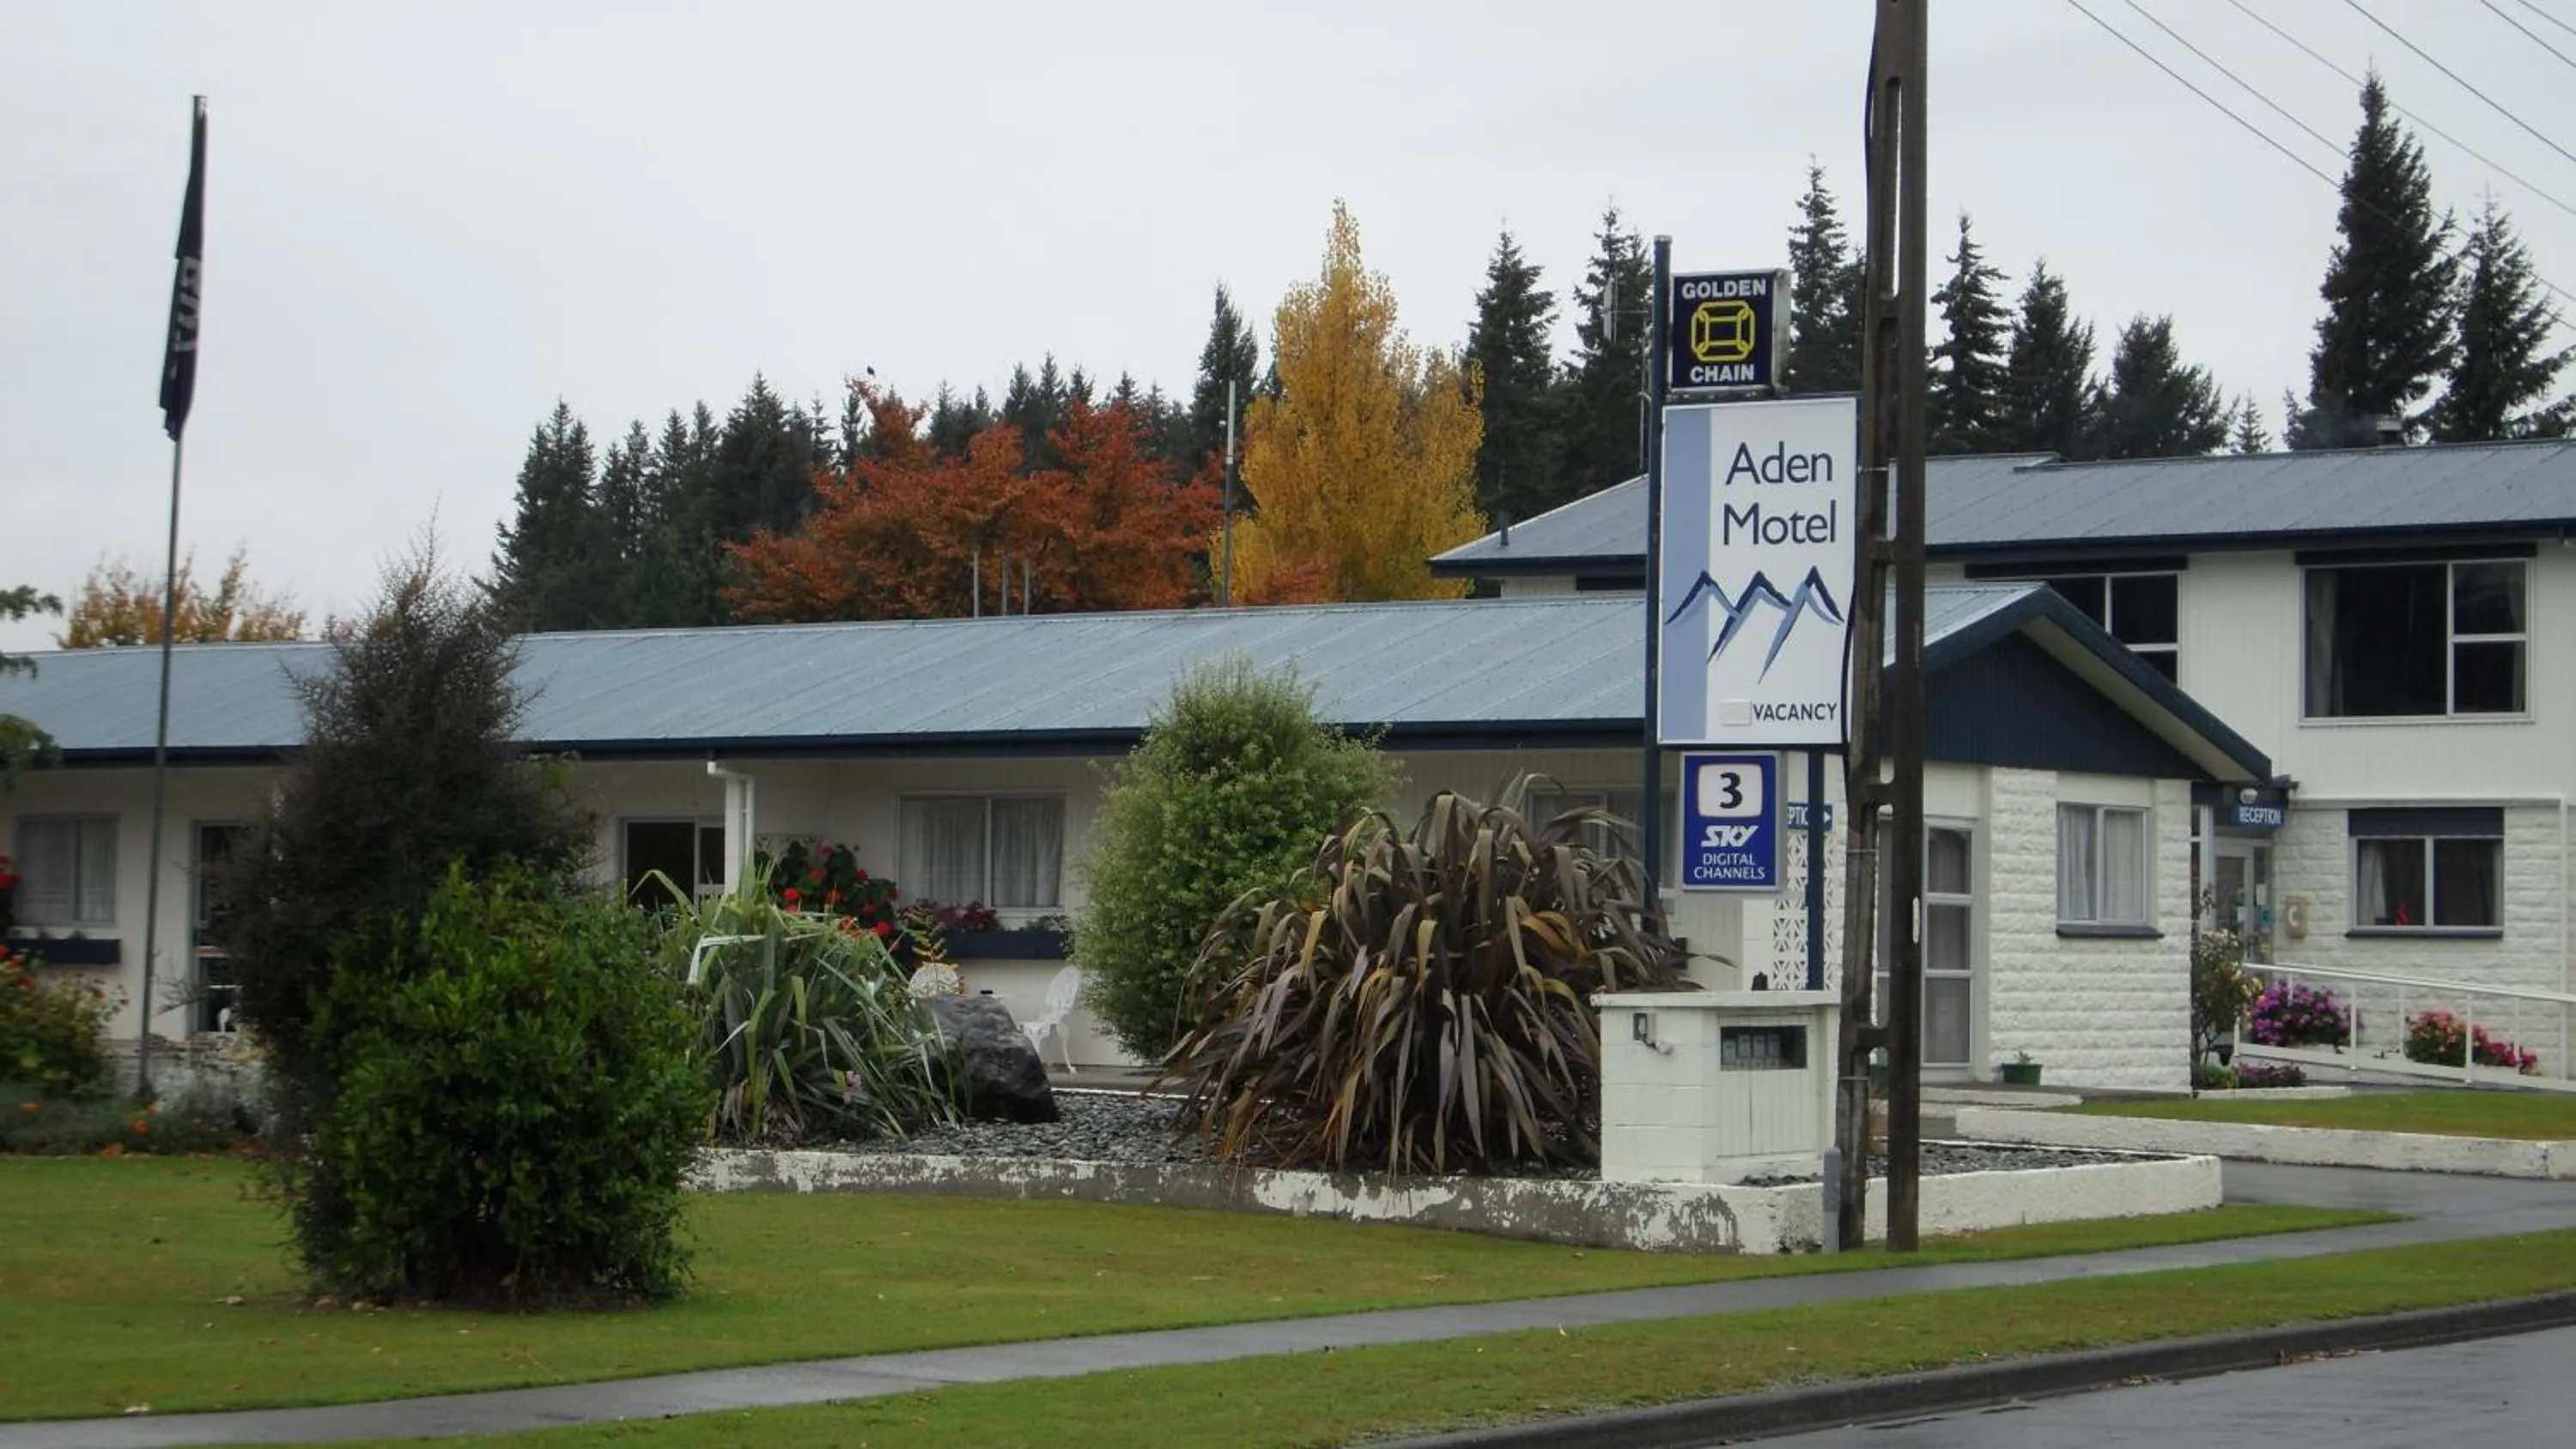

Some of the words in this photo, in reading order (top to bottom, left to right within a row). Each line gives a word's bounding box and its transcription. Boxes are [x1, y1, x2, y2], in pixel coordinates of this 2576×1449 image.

[1681, 279, 1766, 299] GOLDEN
[1690, 363, 1754, 383] CHAIN
[1725, 440, 1833, 486] Aden
[1723, 499, 1837, 546] Motel
[1753, 702, 1838, 722] VACANCY
[1719, 772, 1743, 809] 3
[2239, 806, 2281, 824] RECEPTION
[1701, 825, 1759, 848] SKY
[1703, 852, 1756, 866] DIGITAL
[1693, 866, 1766, 880] CHANNELS
